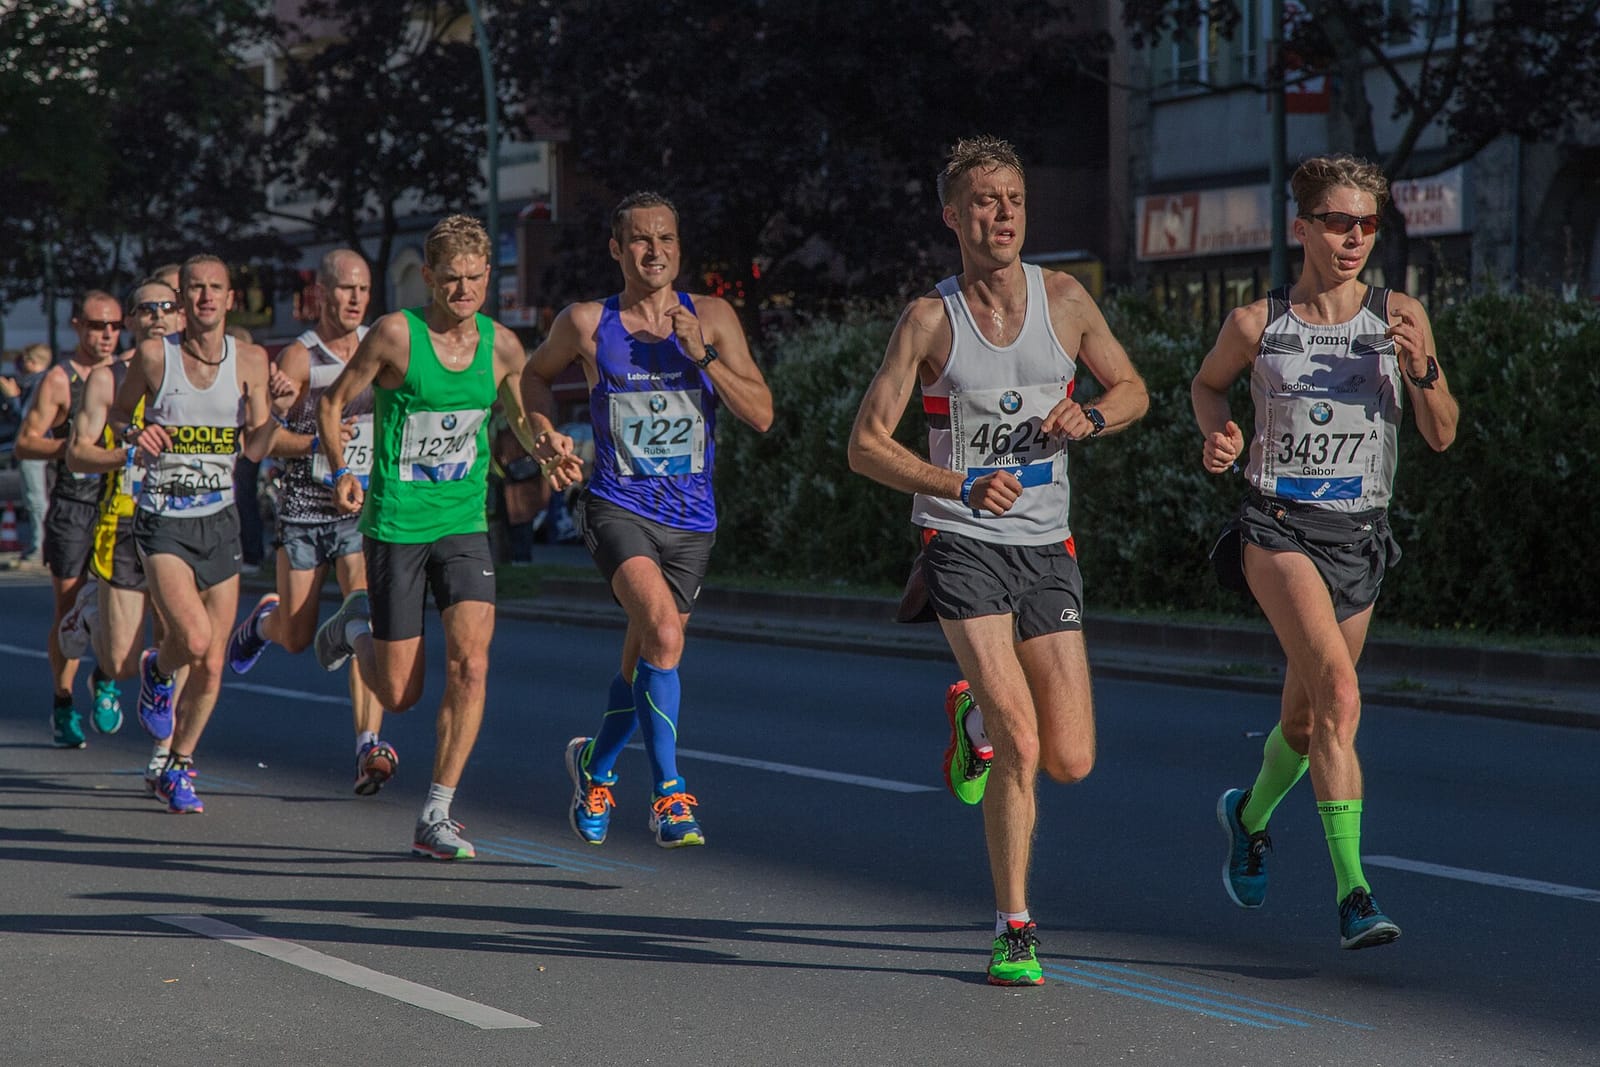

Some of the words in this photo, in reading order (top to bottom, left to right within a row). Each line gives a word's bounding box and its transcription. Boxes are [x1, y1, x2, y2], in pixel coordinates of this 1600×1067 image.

[627, 372, 650, 381] Labor
[628, 417, 693, 446] 122
[1369, 430, 1378, 440] A
[970, 421, 1050, 455] 4624
[165, 443, 211, 454] thletic
[1278, 433, 1365, 465] 34377
[994, 455, 1027, 466] Niklas
[1302, 466, 1335, 476] Gabor
